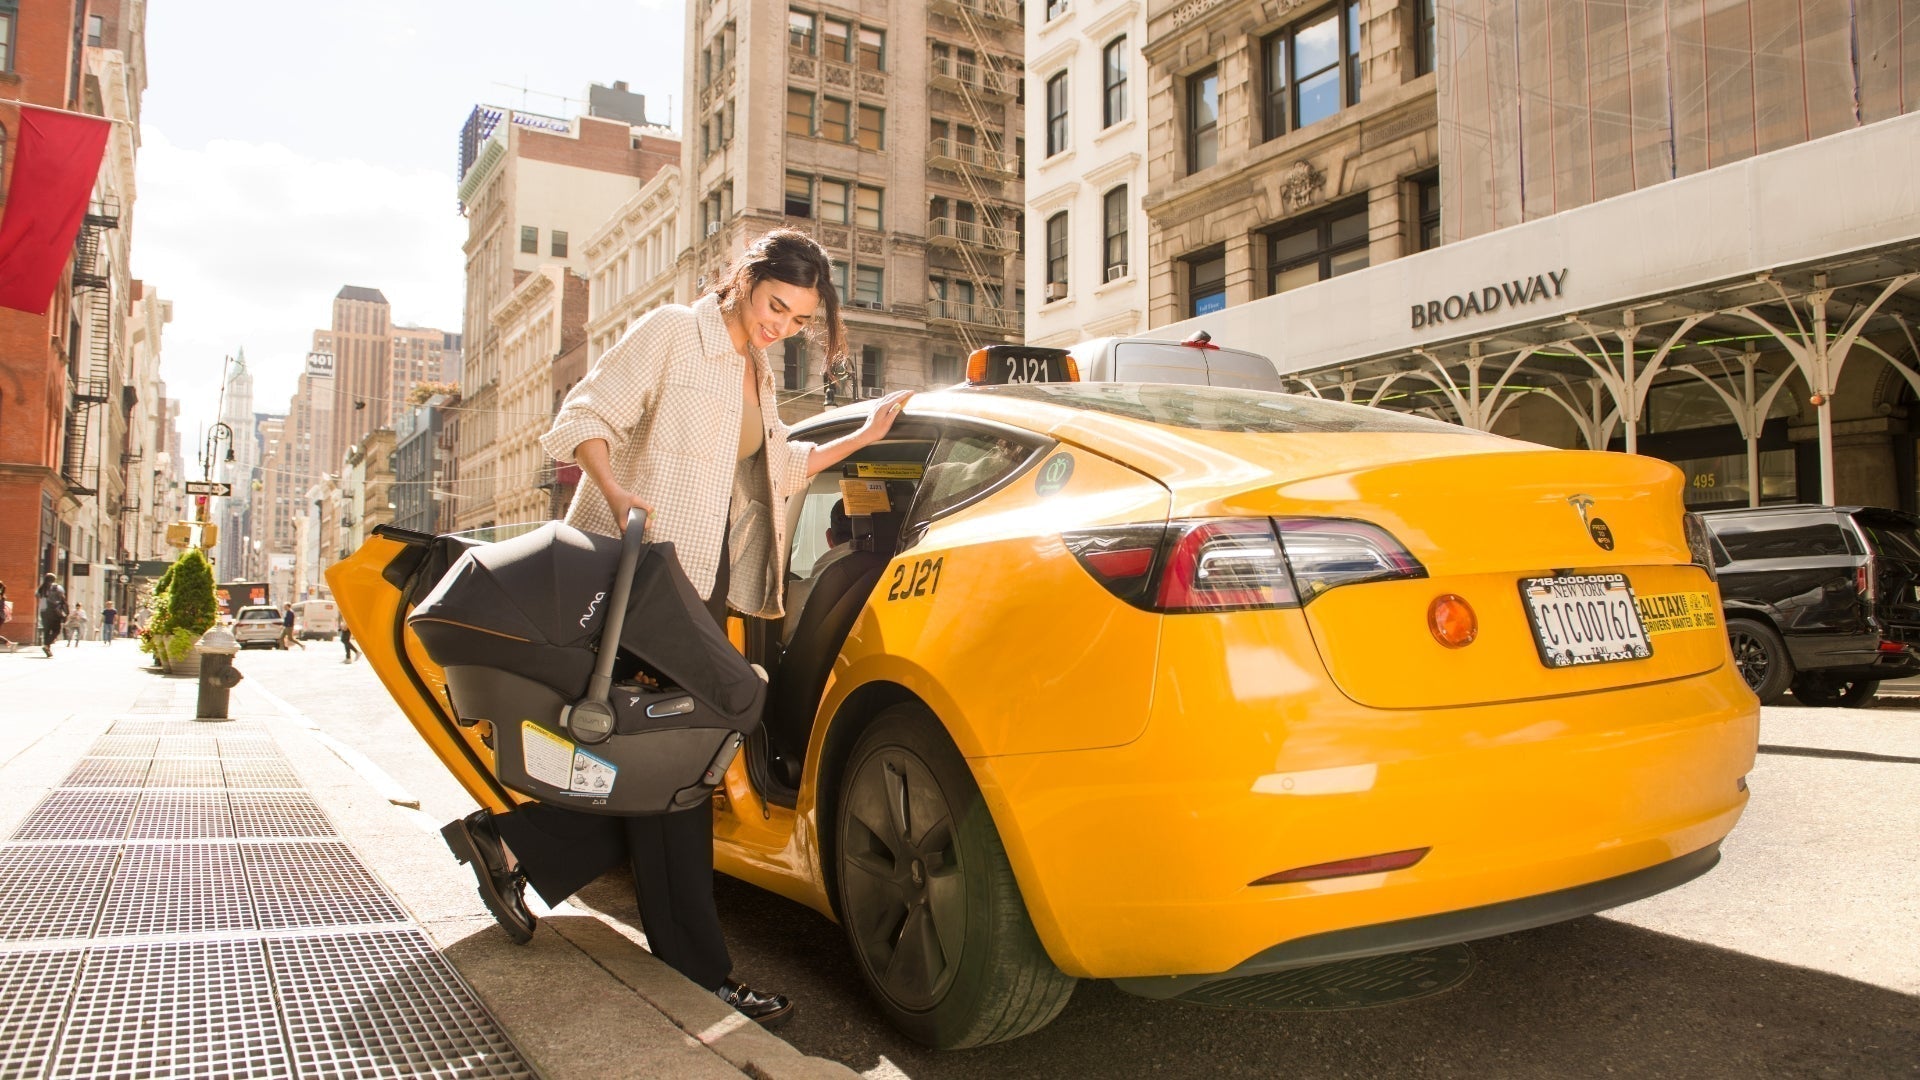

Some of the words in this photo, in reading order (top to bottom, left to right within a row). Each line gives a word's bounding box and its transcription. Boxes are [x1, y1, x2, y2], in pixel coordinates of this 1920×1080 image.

[1411, 268, 1567, 328] BROADWAY
[309, 354, 332, 366] 401
[1006, 357, 1049, 384] 2J21
[1693, 473, 1715, 489] 495
[888, 557, 943, 601] 2J21
[1527, 574, 1623, 587] 718-000-0000
[1553, 584, 1577, 598] NEW
[1579, 582, 1606, 597] YORK
[580, 592, 606, 628] nuna
[1541, 600, 1637, 645] C1C00762
[1645, 619, 1671, 632] DRIVERS
[1671, 617, 1693, 629] WANTED
[1573, 654, 1599, 665] ALL
[1600, 651, 1633, 661] TAXI
[1591, 646, 1608, 655] TAXI
